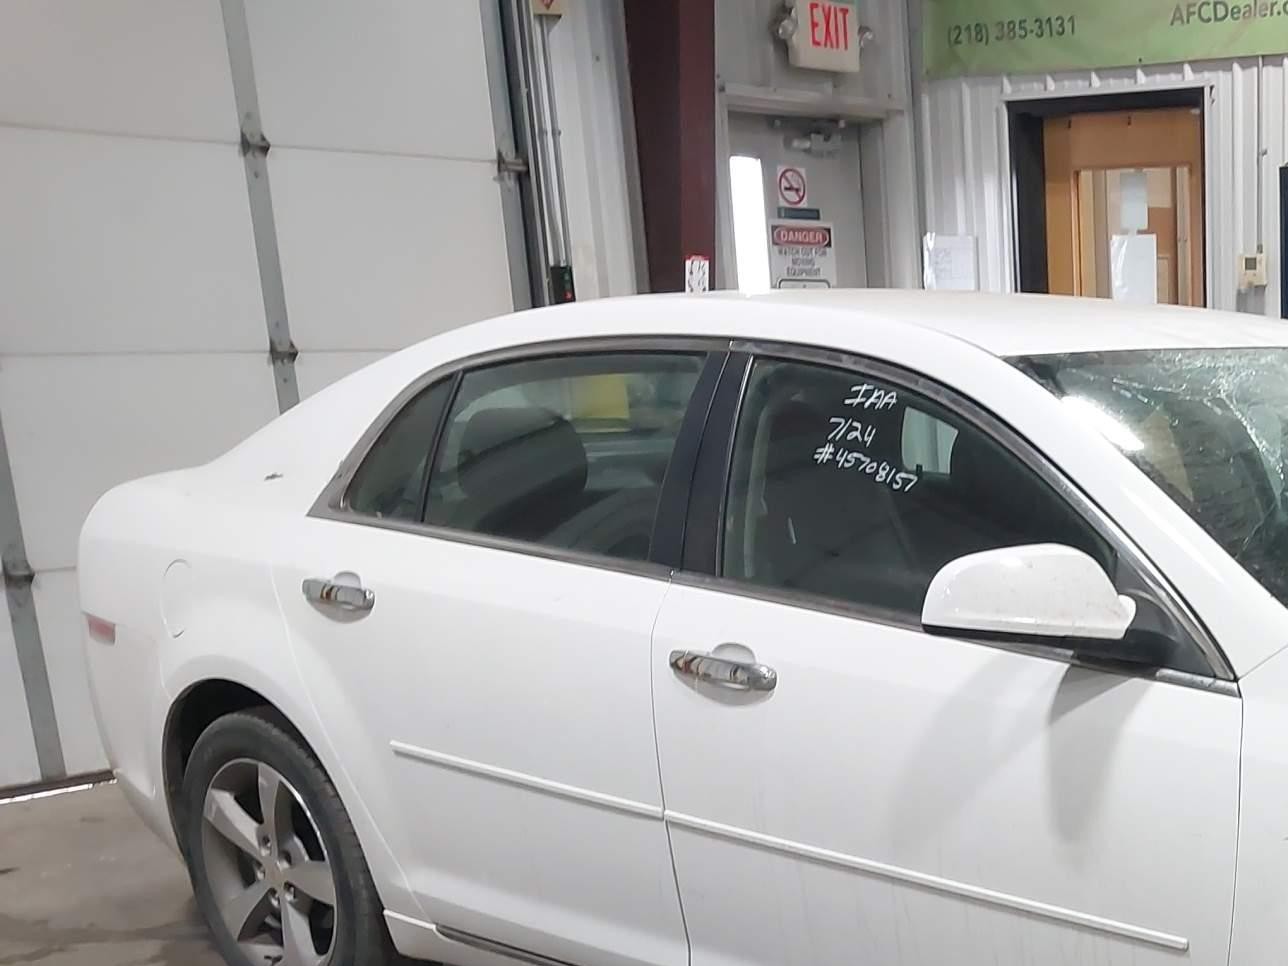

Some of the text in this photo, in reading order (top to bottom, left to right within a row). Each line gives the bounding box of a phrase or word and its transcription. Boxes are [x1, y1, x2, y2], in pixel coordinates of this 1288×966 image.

[809, 3, 849, 51] EXIT
[947, 15, 1076, 45] (218) 385-3131
[780, 231, 823, 243] DANGER
[844, 383, 898, 410] IAA
[813, 442, 918, 492] #45708157
